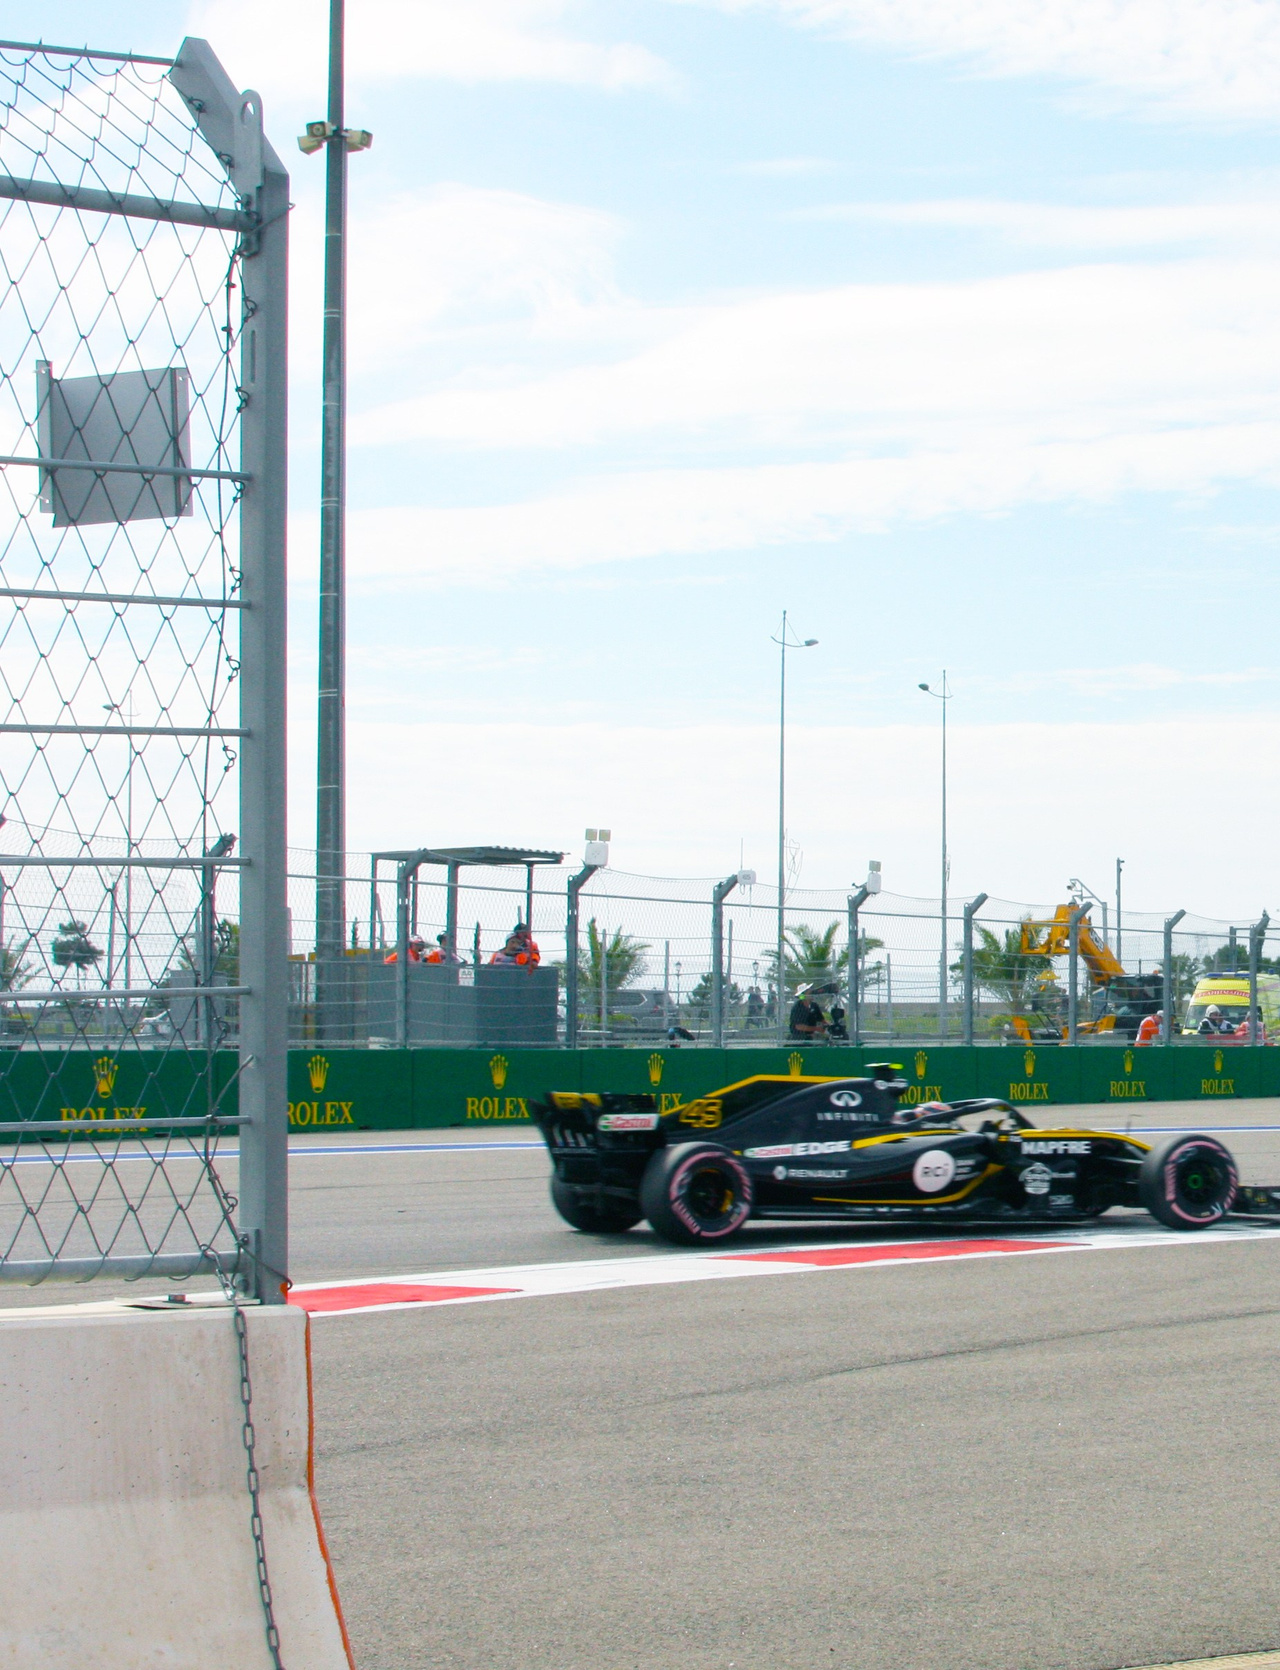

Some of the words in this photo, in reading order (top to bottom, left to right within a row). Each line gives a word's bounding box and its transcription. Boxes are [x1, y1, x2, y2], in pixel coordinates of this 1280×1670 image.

[1009, 1083, 1050, 1101] ROLEX
[1110, 1080, 1147, 1098] ROLEX
[1201, 1078, 1235, 1095] ROLEX
[466, 1097, 530, 1119] ROLEX
[60, 1107, 148, 1134] ROLEX
[795, 1140, 852, 1156] EDGE
[1021, 1141, 1092, 1155] MAPFRE
[787, 1168, 850, 1179] RENAULT
